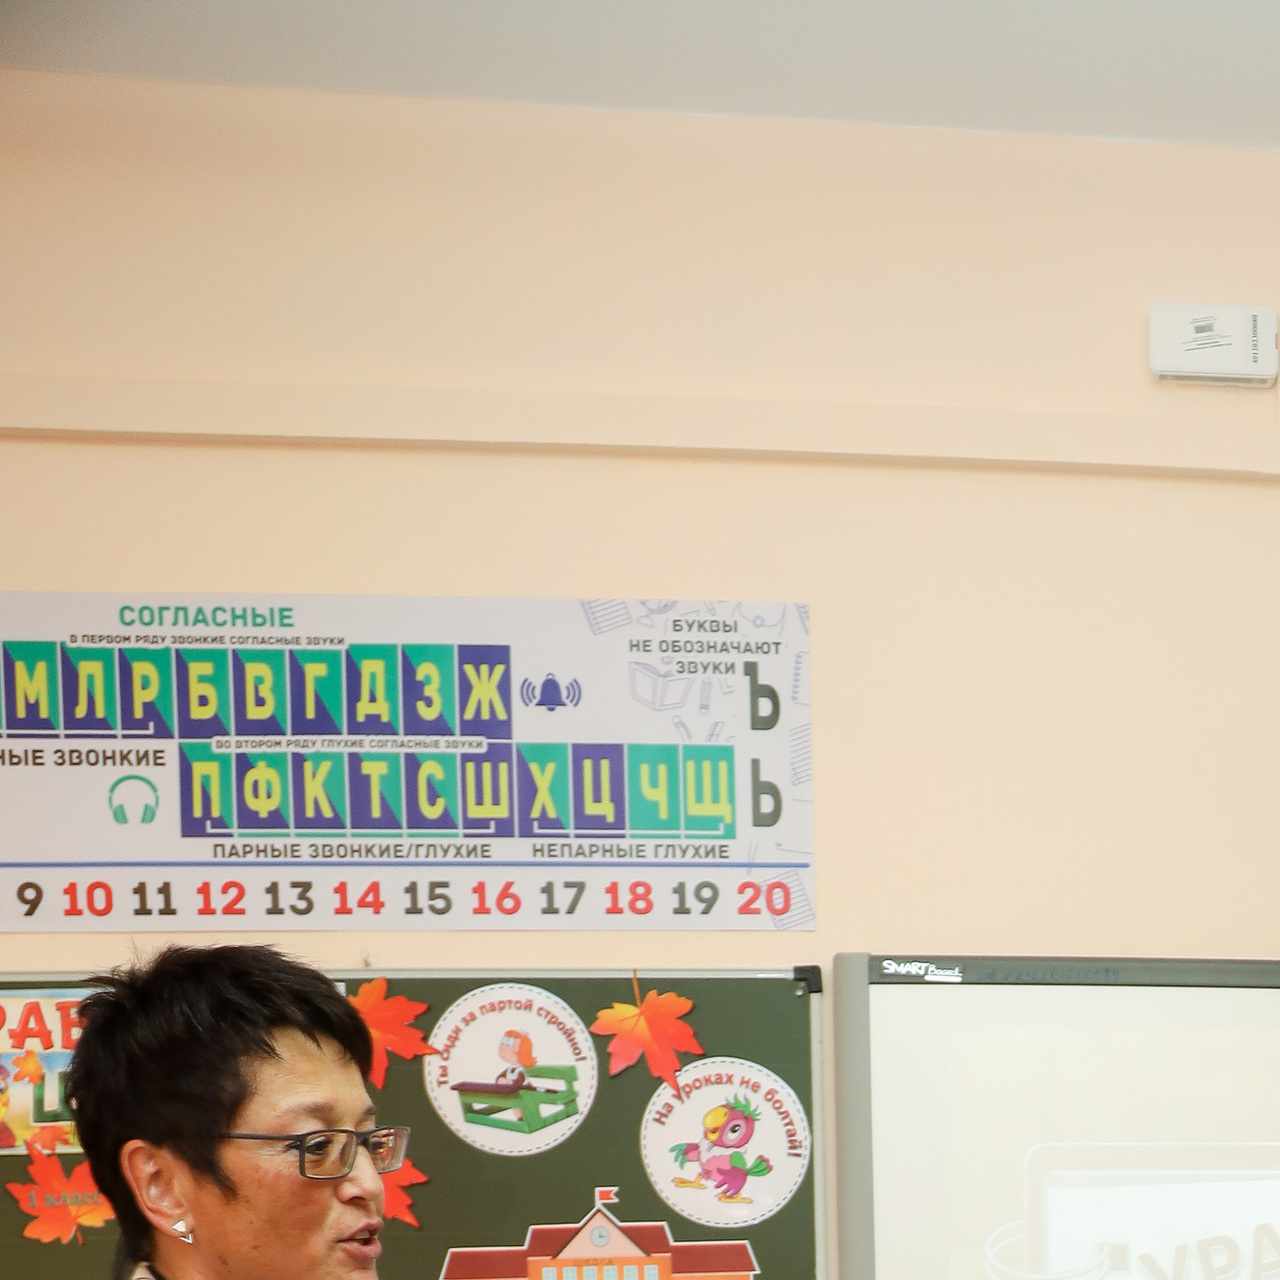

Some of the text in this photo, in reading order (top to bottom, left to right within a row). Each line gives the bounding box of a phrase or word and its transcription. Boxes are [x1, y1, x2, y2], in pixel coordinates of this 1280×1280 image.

[119, 606, 294, 627] СОГЛАСНЫЕ
[672, 619, 738, 633] БУКВЫ
[69, 634, 345, 647] В ПЕРВОМ РЯДУ ЗВОНКИЕ СОГЛАСНЫЕ ЗВУКИ
[629, 640, 782, 655] НЕ ОБОЗНАЧАЮТ
[675, 660, 736, 675] ЗВУКИ
[14, 658, 508, 722] М Л Р Б В Г Д З Ж
[743, 660, 781, 731] Ъ
[215, 739, 484, 751] ВО ВТОРОМ РЯДУ ГЛУХИЕ СОГЛАСНЫЕ ЗВУКИ
[53, 749, 166, 767] ЗВОНКИЕ
[192, 758, 732, 824] П Ф К Т С Ш Х Ц Ч Щ
[751, 757, 783, 827] Ь
[213, 843, 492, 860] ПАРНЫЕ ЗВОНКИЕ/ГЛУХИЕ
[532, 843, 731, 860] НЕПАРНЫЕ ГЛУХИЕ
[16, 880, 792, 916] 9 10 11 12 13 14 15 16 17 18 19 20
[882, 959, 930, 976] SMART
[436, 1064, 449, 1088] Ты
[460, 1010, 477, 1027] за
[478, 998, 534, 1015] партой
[536, 1006, 588, 1062] стройно!
[652, 1101, 675, 1126] На
[739, 1074, 762, 1093] не
[763, 1086, 803, 1158] болтай!
[28, 1190, 102, 1208] 1 класс
